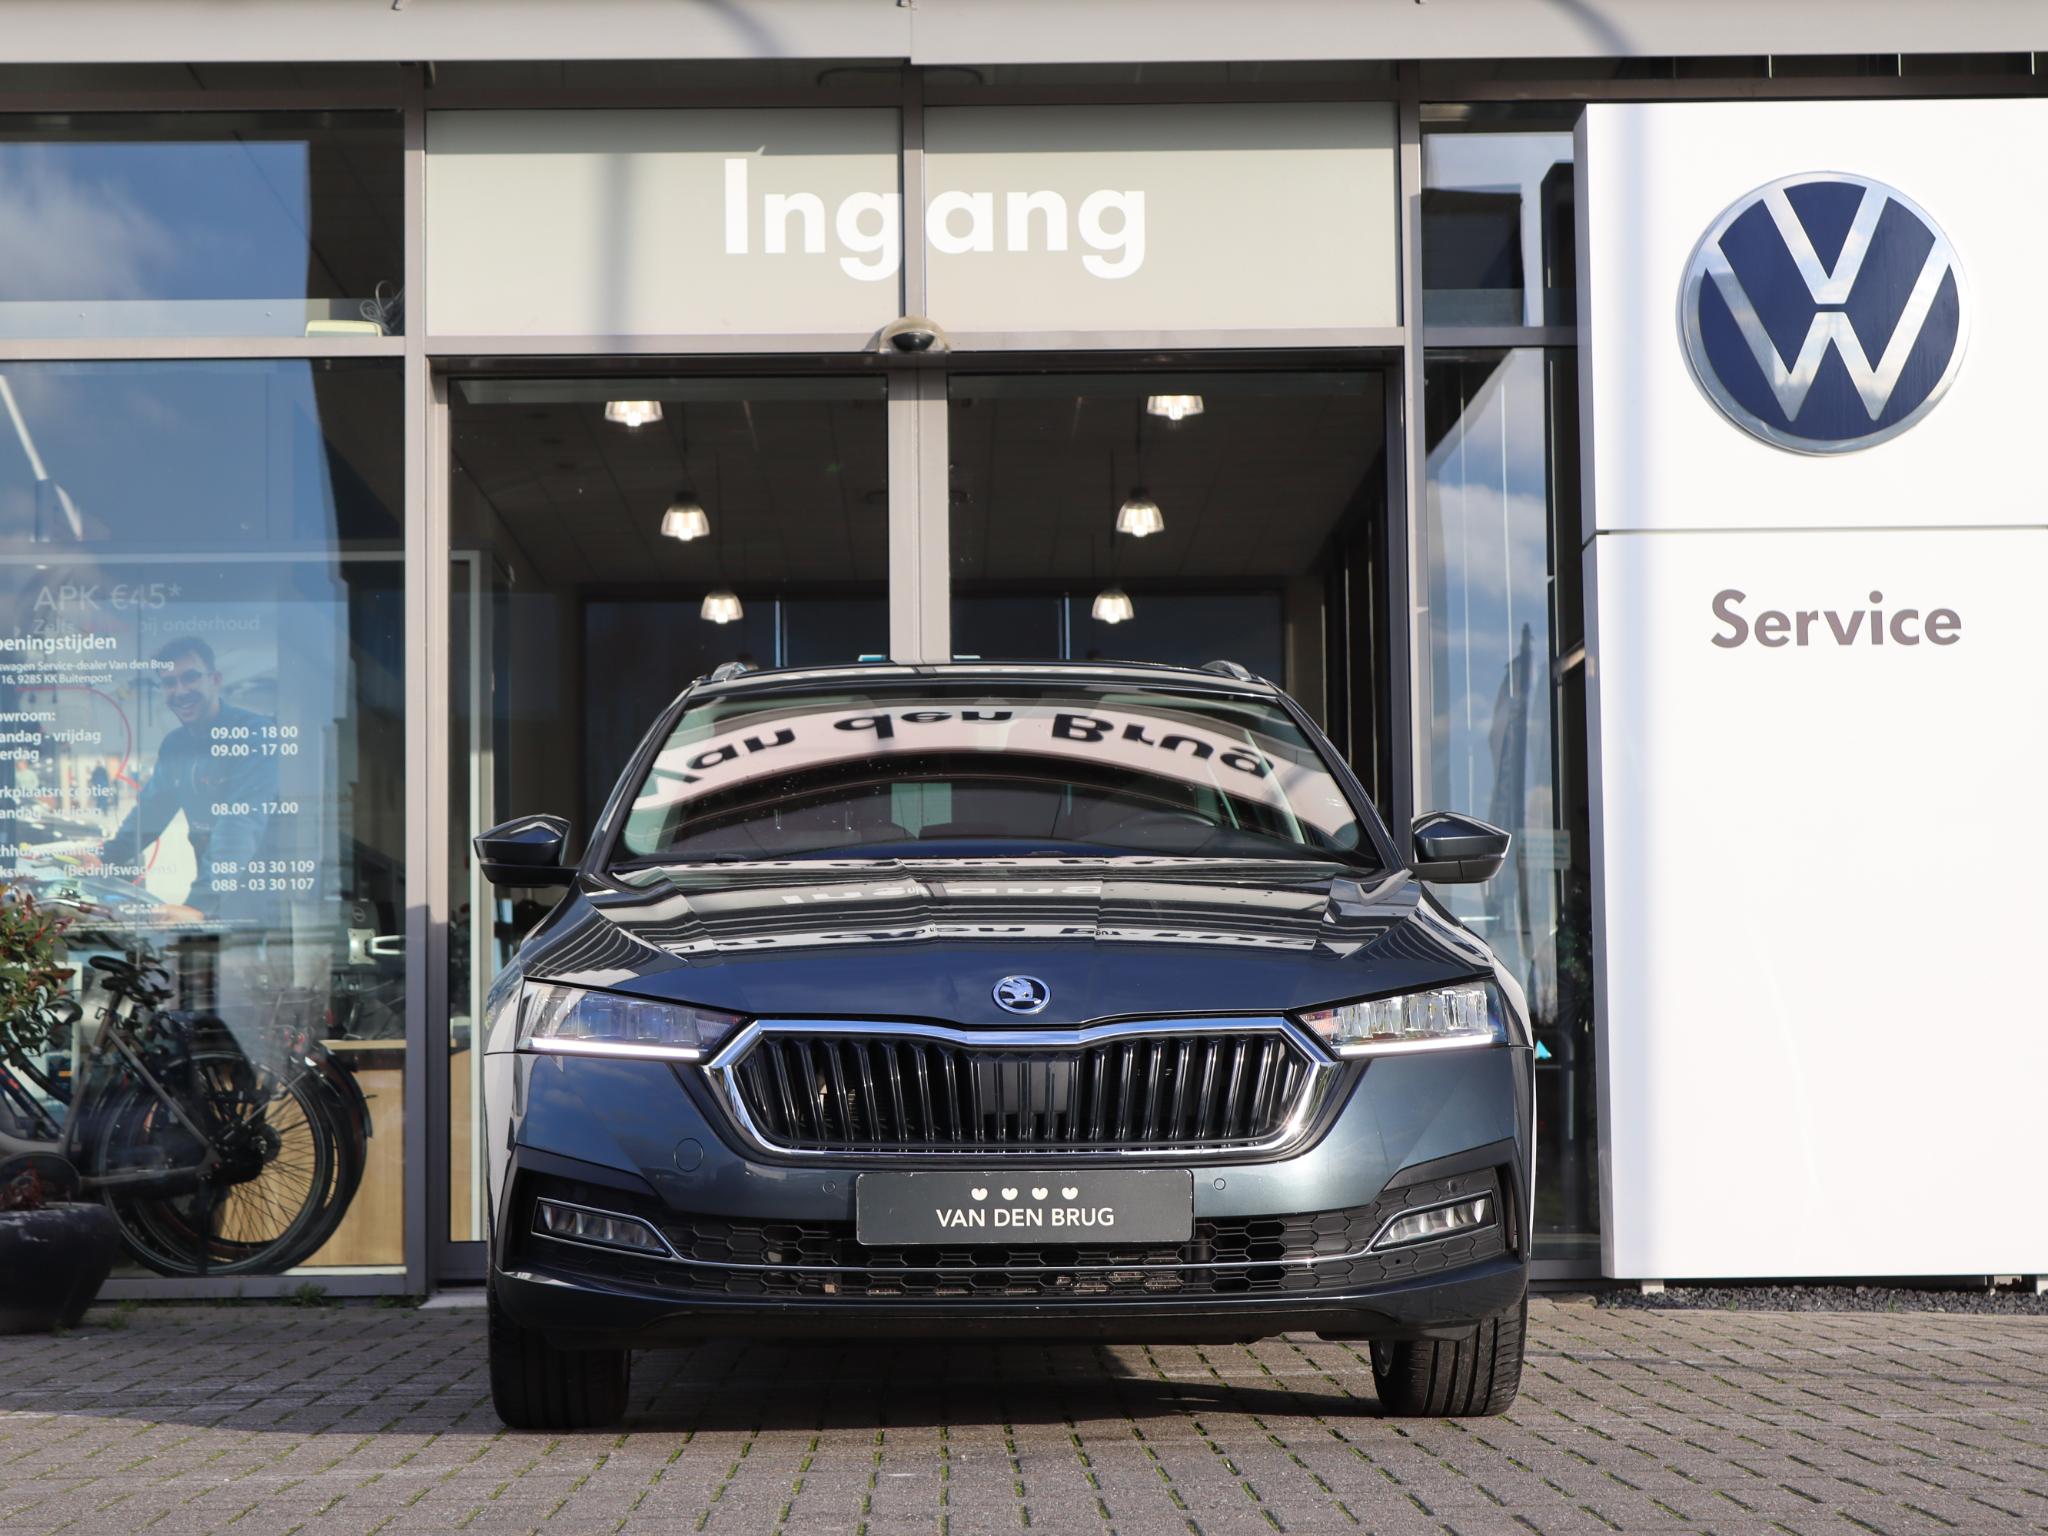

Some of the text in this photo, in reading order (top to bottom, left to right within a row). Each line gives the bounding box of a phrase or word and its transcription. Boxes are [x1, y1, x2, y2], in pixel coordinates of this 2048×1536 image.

[725, 159, 1146, 281] Ingang
[34, 585, 100, 611] APK
[163, 615, 260, 631] onderhoud
[1710, 588, 1962, 649] Service
[0, 633, 117, 654] eningstijden
[37, 659, 107, 672] Service-dealer
[108, 660, 128, 670] Van
[129, 658, 149, 670] den
[151, 658, 175, 671] Brug
[18, 674, 42, 684] 9285
[44, 674, 57, 684] KK
[59, 673, 113, 685] Buitenpost
[52, 729, 101, 744] vrijdag
[210, 727, 249, 740] 09.00
[210, 744, 249, 757] 09.00
[211, 803, 249, 815] 08.00
[261, 802, 298, 815] 17.00
[211, 862, 238, 874] 088
[248, 862, 265, 873] 03
[269, 861, 286, 873] 30
[290, 860, 315, 873] 109
[211, 879, 238, 892] 088
[248, 879, 265, 891] 03
[269, 878, 286, 891] 30
[290, 878, 315, 890] 107
[936, 1207, 1114, 1228] VAN DEN BRUG
